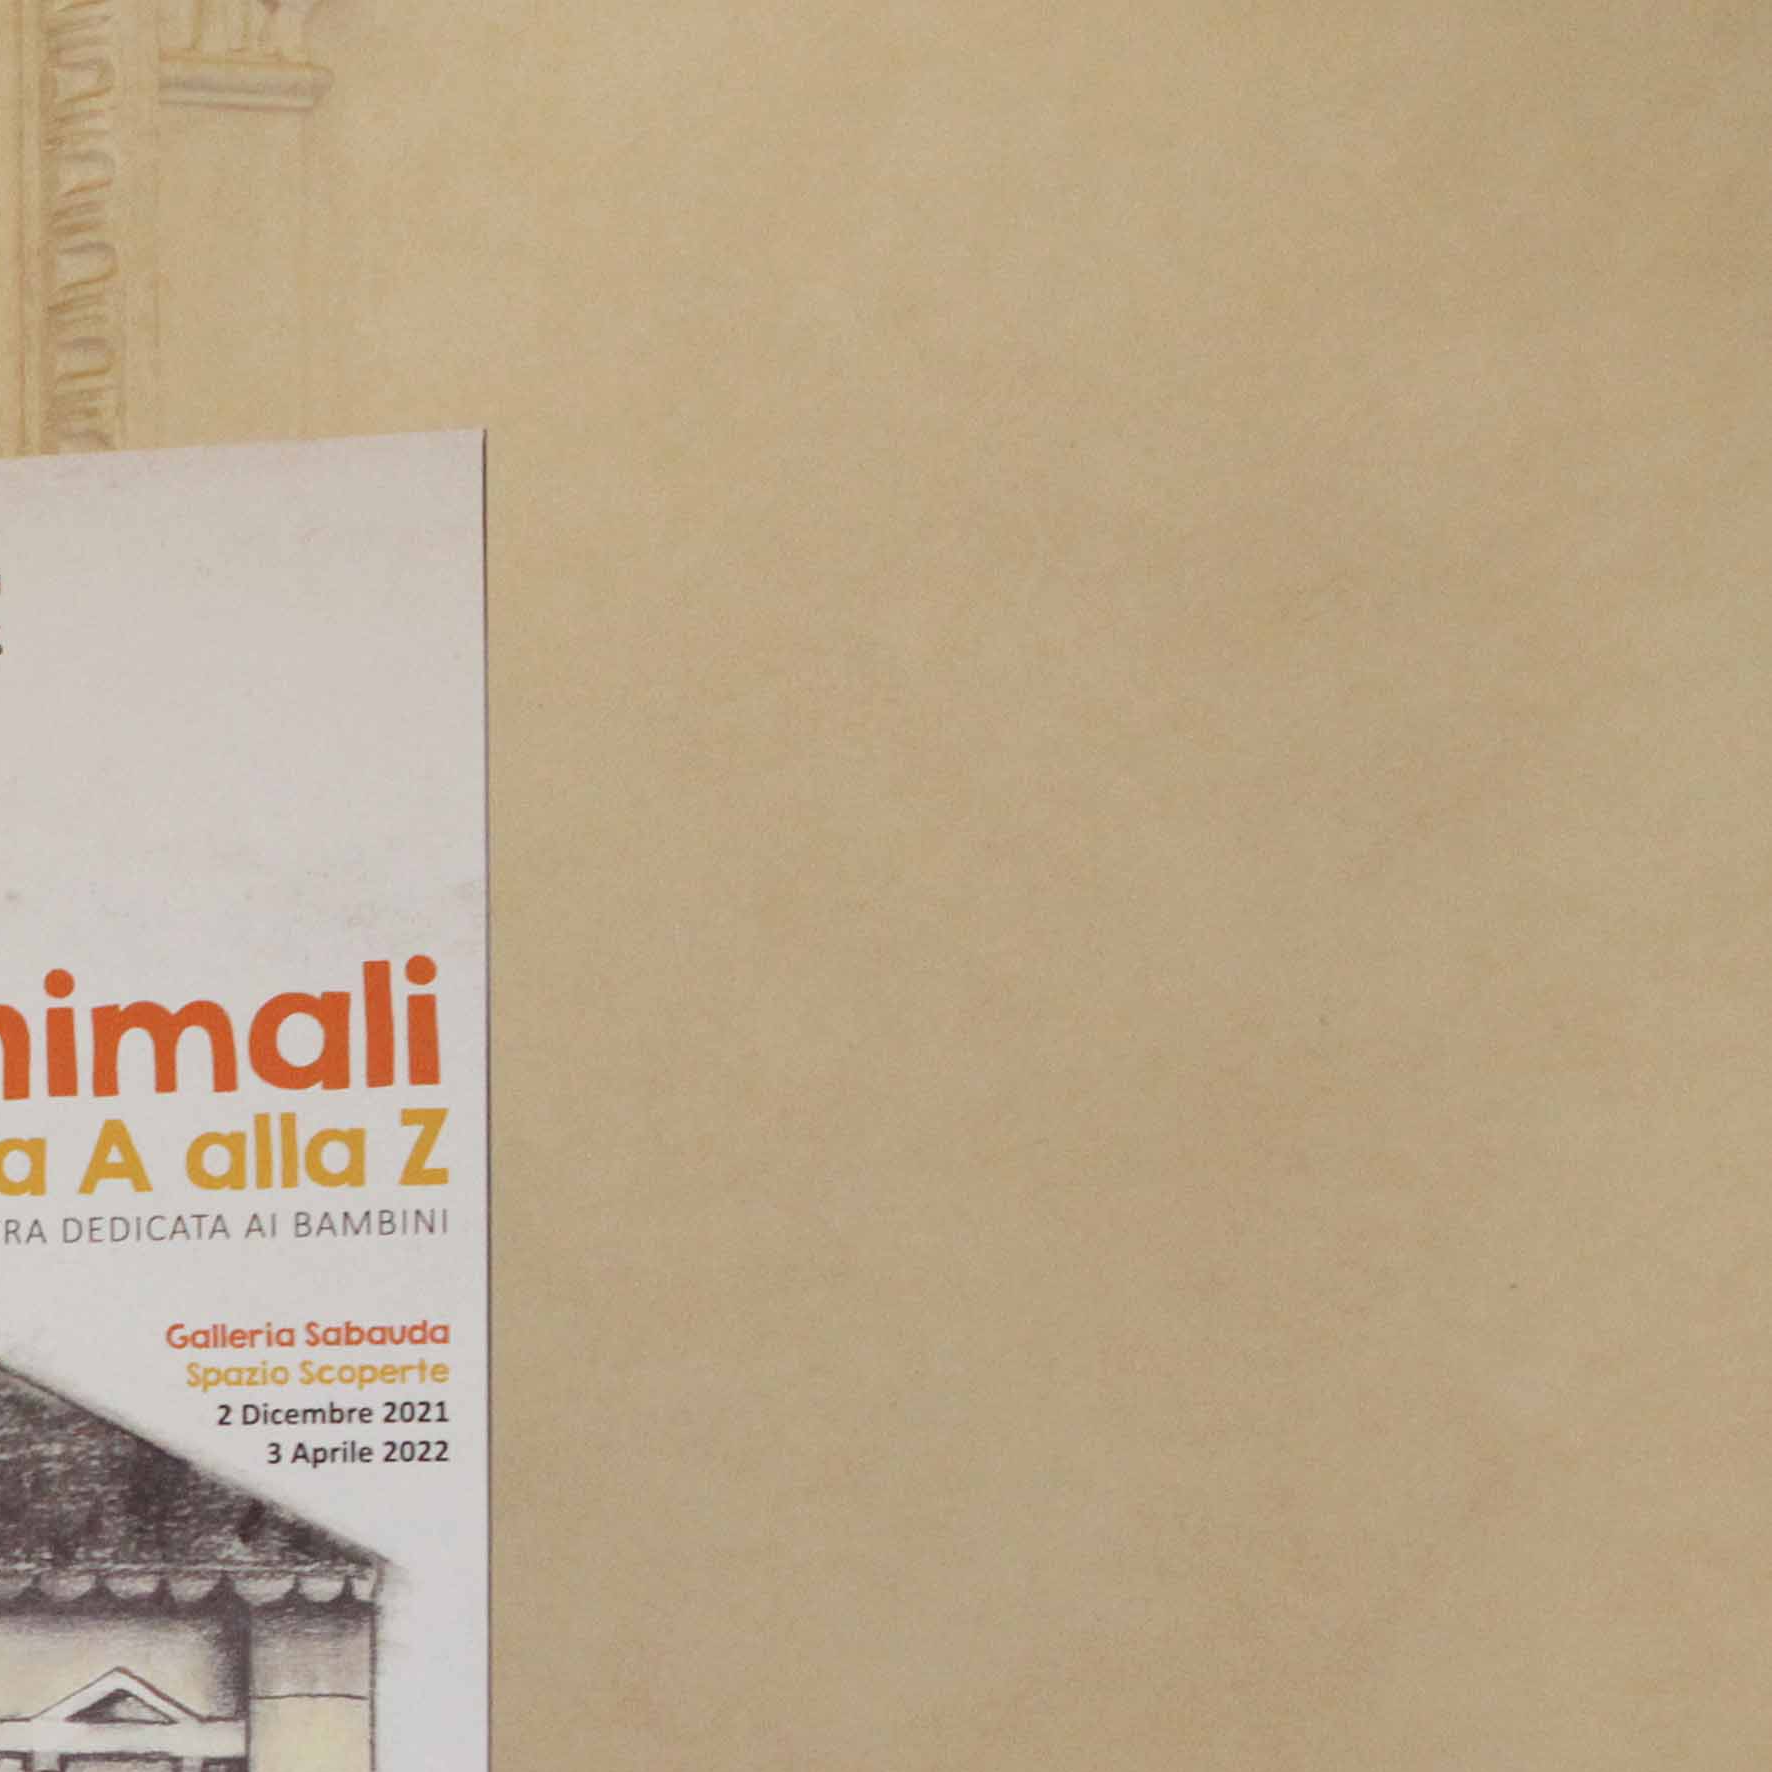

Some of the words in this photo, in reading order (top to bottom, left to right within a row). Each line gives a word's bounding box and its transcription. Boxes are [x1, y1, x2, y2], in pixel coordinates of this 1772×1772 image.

[79, 1120, 153, 1195] A
[186, 1112, 366, 1190] alla
[400, 1108, 448, 1185] Z
[63, 1214, 230, 1243] DEDICATA
[245, 1213, 276, 1238] AI
[295, 1208, 447, 1238] BAMBINI
[166, 1322, 295, 1349] Galleria
[305, 1320, 449, 1347] Sabauda
[188, 1362, 288, 1391] Spazio
[301, 1361, 448, 1389] Scoperte
[217, 1404, 232, 1426] 2
[242, 1401, 373, 1425] Dicembre
[383, 1401, 449, 1423] 2021
[268, 1442, 282, 1464] 3
[291, 1440, 374, 1469] Aprile
[383, 1440, 449, 1462] 2022
